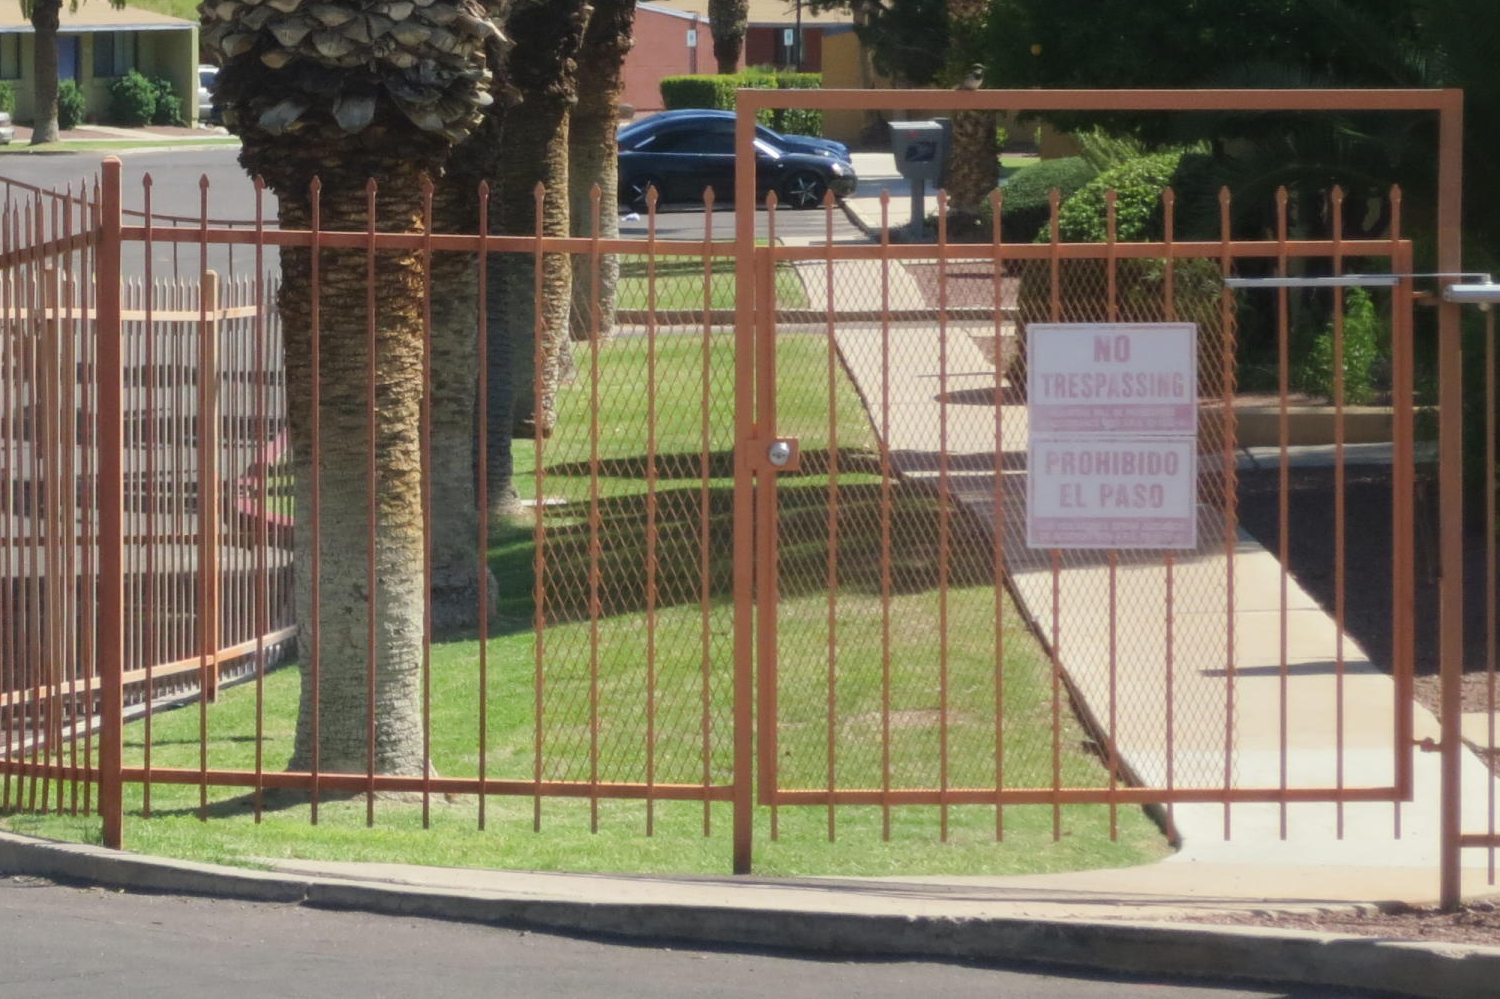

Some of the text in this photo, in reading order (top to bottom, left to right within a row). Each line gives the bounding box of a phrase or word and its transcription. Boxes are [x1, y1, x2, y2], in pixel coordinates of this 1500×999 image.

[1093, 335, 1130, 362] NO
[1041, 372, 1184, 399] TRESPASSING
[1045, 451, 1179, 476] PROHIBIDO
[1059, 483, 1164, 508] EL PASO
